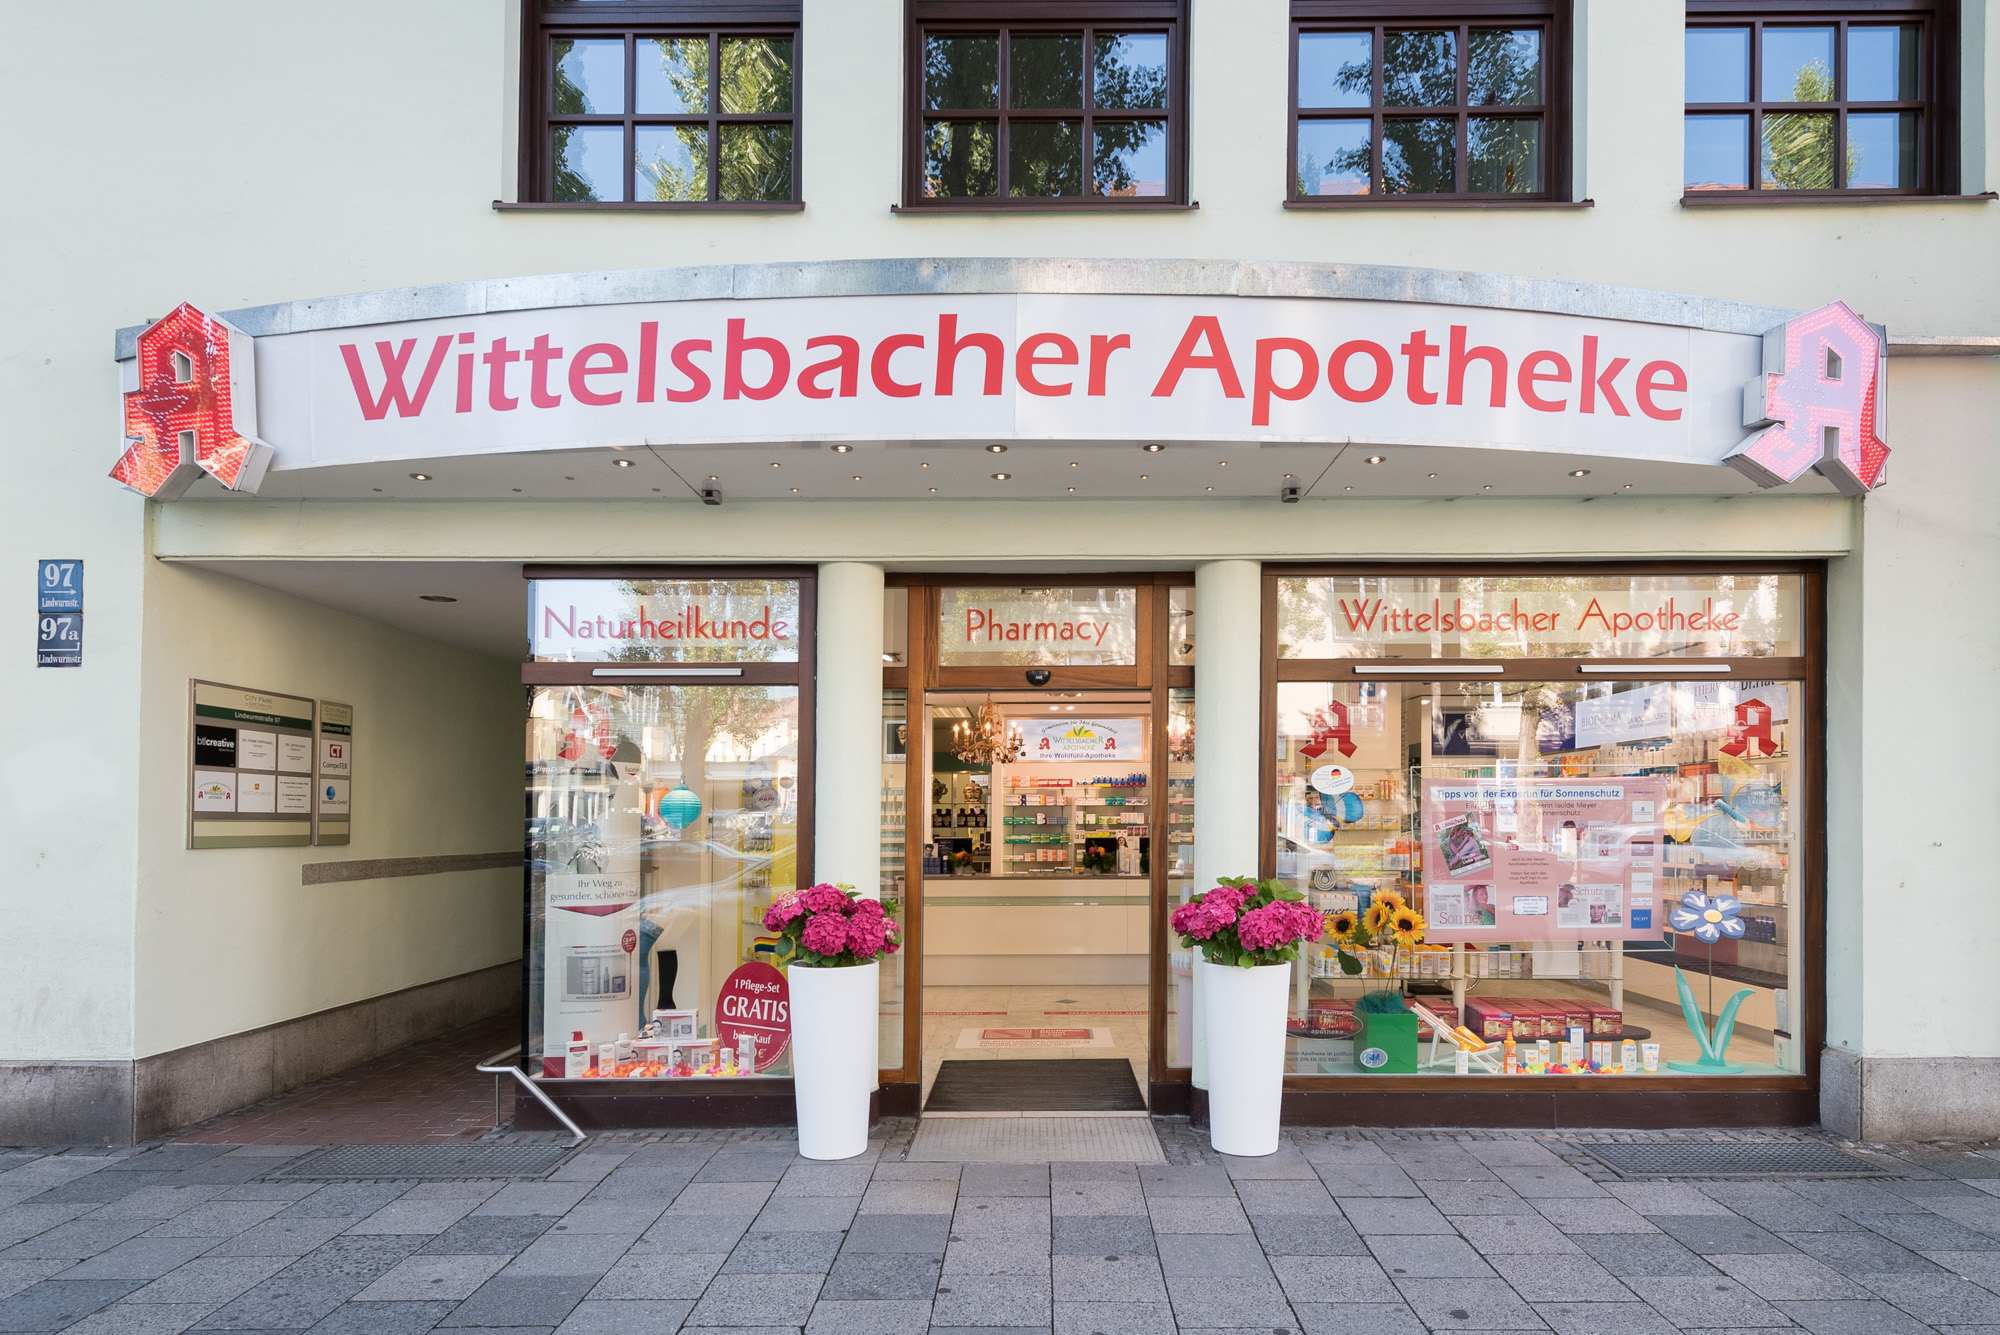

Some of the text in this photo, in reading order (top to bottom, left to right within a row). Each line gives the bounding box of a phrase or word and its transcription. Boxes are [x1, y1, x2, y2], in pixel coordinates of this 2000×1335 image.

[339, 314, 1688, 426] Wittelsbacher Apotheke
[44, 563, 75, 587] 97
[41, 597, 79, 608] Lindwurmstr.
[544, 605, 788, 640] Naturheilkunde
[1340, 597, 1740, 638] Wittelsbacher Apotheke
[40, 617, 80, 641] 97a
[966, 608, 1110, 646] Pharmacy
[1458, 732, 1488, 740] VICH
[1054, 752, 1116, 760] Wohlfühl-Apotheke
[322, 761, 348, 770] CompoTEK
[1437, 790, 1461, 800] Tipps
[1483, 789, 1498, 798] der
[1540, 789, 1553, 798] für
[1555, 789, 1620, 798] Sonnenschutz
[1576, 802, 1598, 812] Meyer
[577, 880, 591, 888] Ihr
[592, 880, 612, 889] Weg
[550, 891, 593, 903] gesunder,
[1573, 886, 1604, 896] Schutz
[740, 978, 780, 994] Pflege-Set
[722, 994, 788, 1023] GRATIS
[753, 1032, 772, 1045] Kauf
